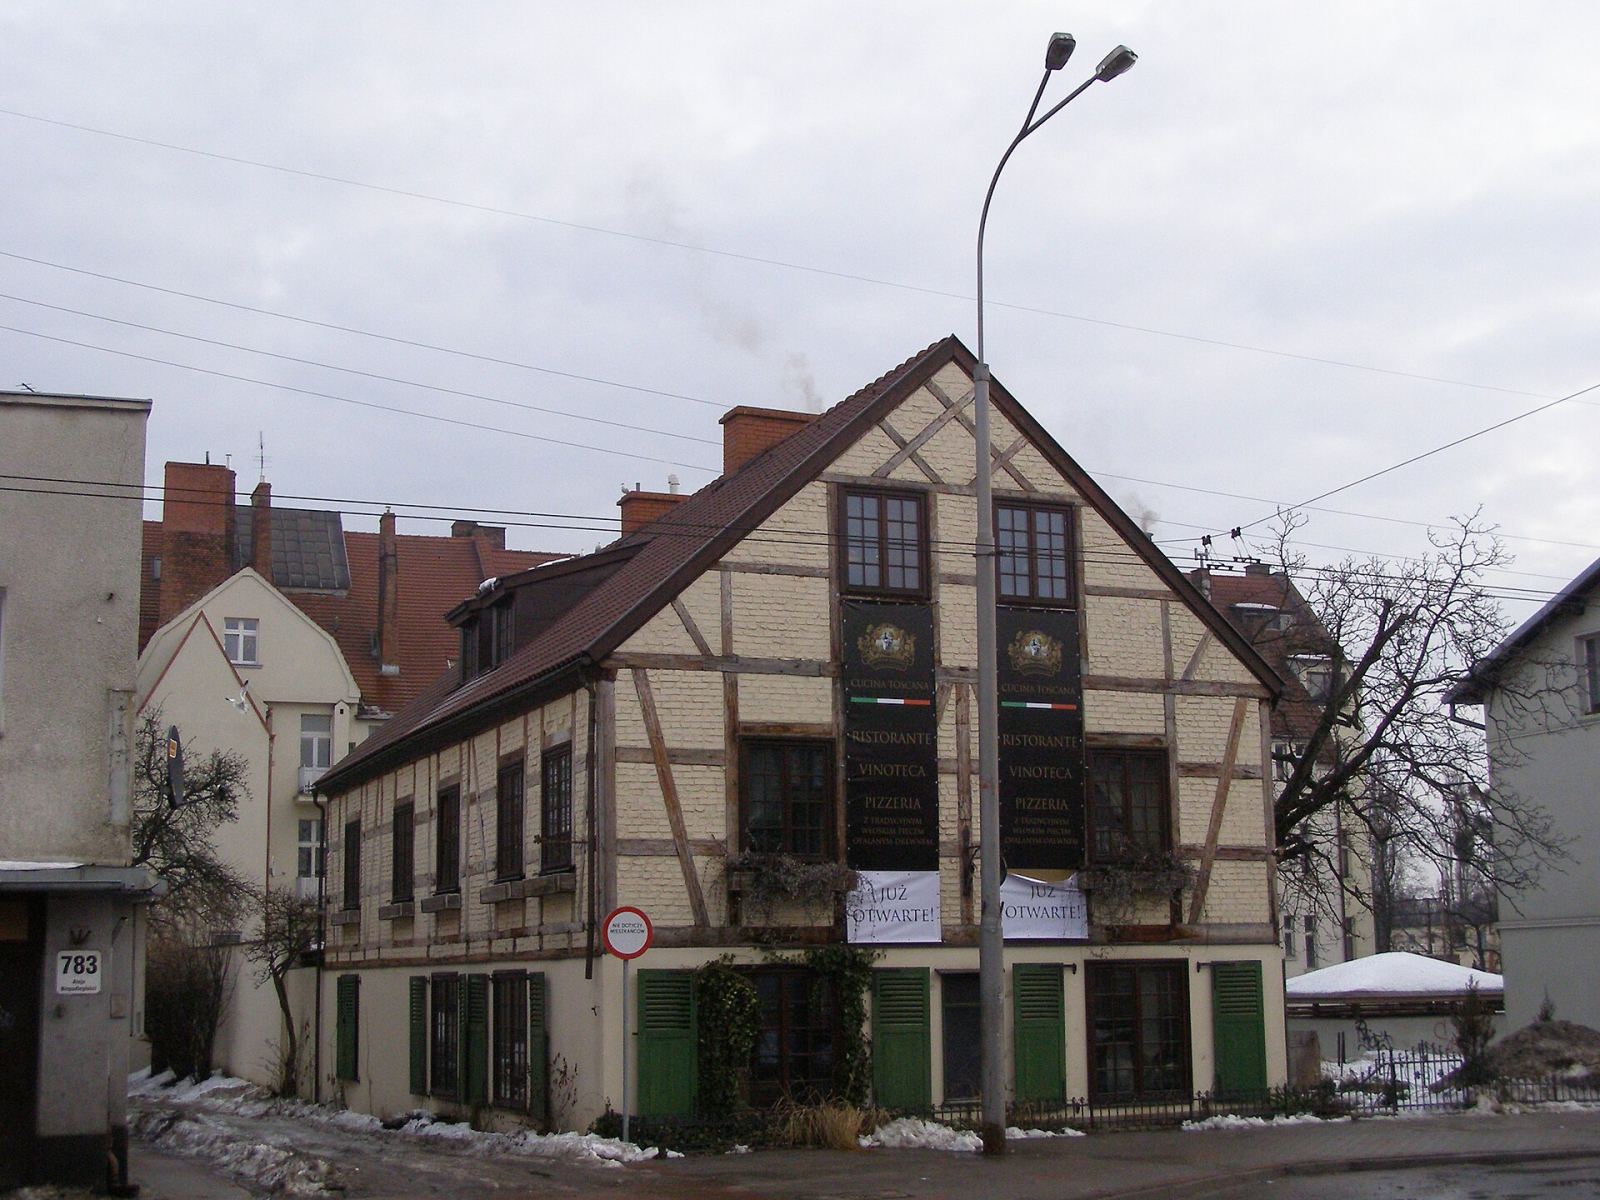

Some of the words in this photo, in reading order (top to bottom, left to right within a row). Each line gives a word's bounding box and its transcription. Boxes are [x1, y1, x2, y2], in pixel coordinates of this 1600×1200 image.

[850, 679, 887, 689] CUCINA
[889, 680, 930, 690] TOSCANA
[852, 730, 932, 745] RISTORANTE
[1002, 733, 1078, 748] RISTORANTE
[859, 763, 926, 777] VINOTECA
[1009, 765, 1072, 779] VINOTECA
[865, 796, 921, 809] PIZZERIA
[1015, 797, 1069, 810] PIZZERIA
[880, 884, 908, 904] JUŻ
[853, 907, 934, 922] OTWARTE!
[1005, 904, 1081, 920] OTWARTE!
[61, 955, 98, 975] 783
